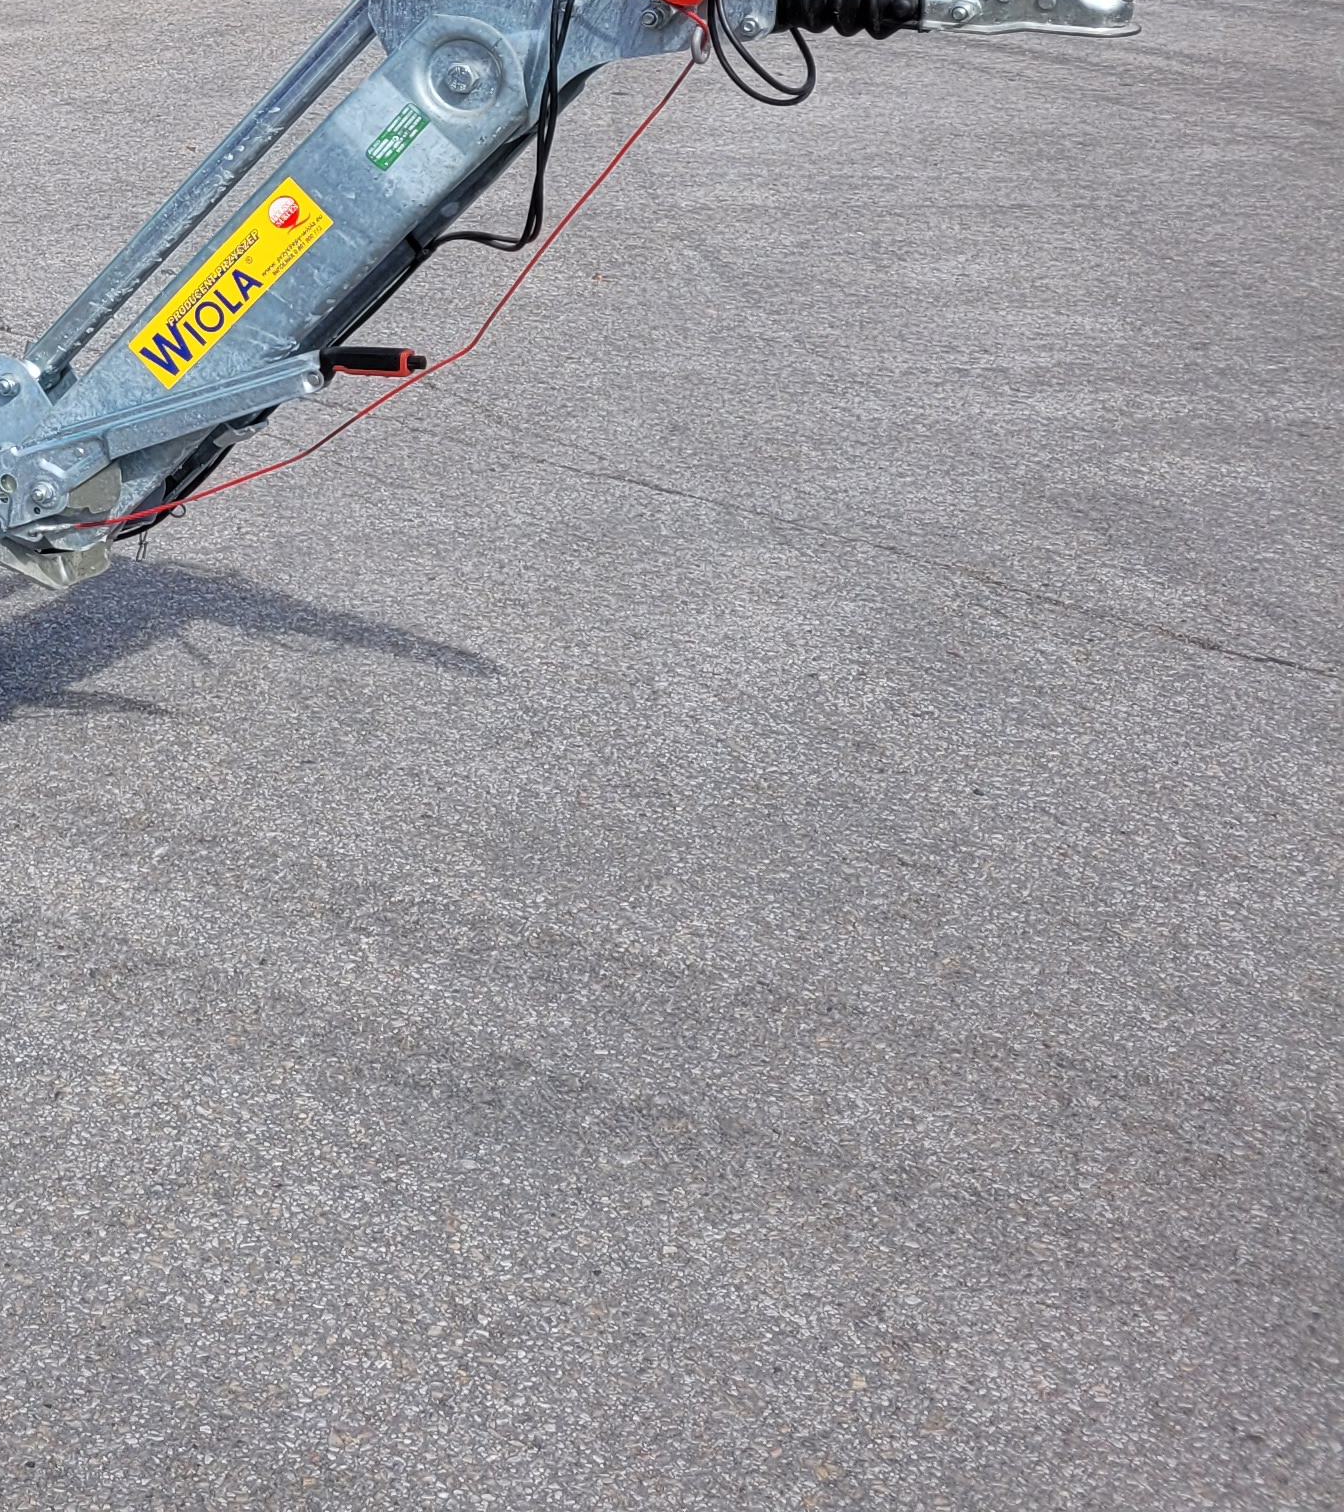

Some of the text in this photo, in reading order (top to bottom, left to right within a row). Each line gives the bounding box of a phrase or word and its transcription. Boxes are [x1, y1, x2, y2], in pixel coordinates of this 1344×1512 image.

[138, 268, 264, 377] WIOLA
[166, 228, 260, 326] PRODUCENT PRZYCZEP
